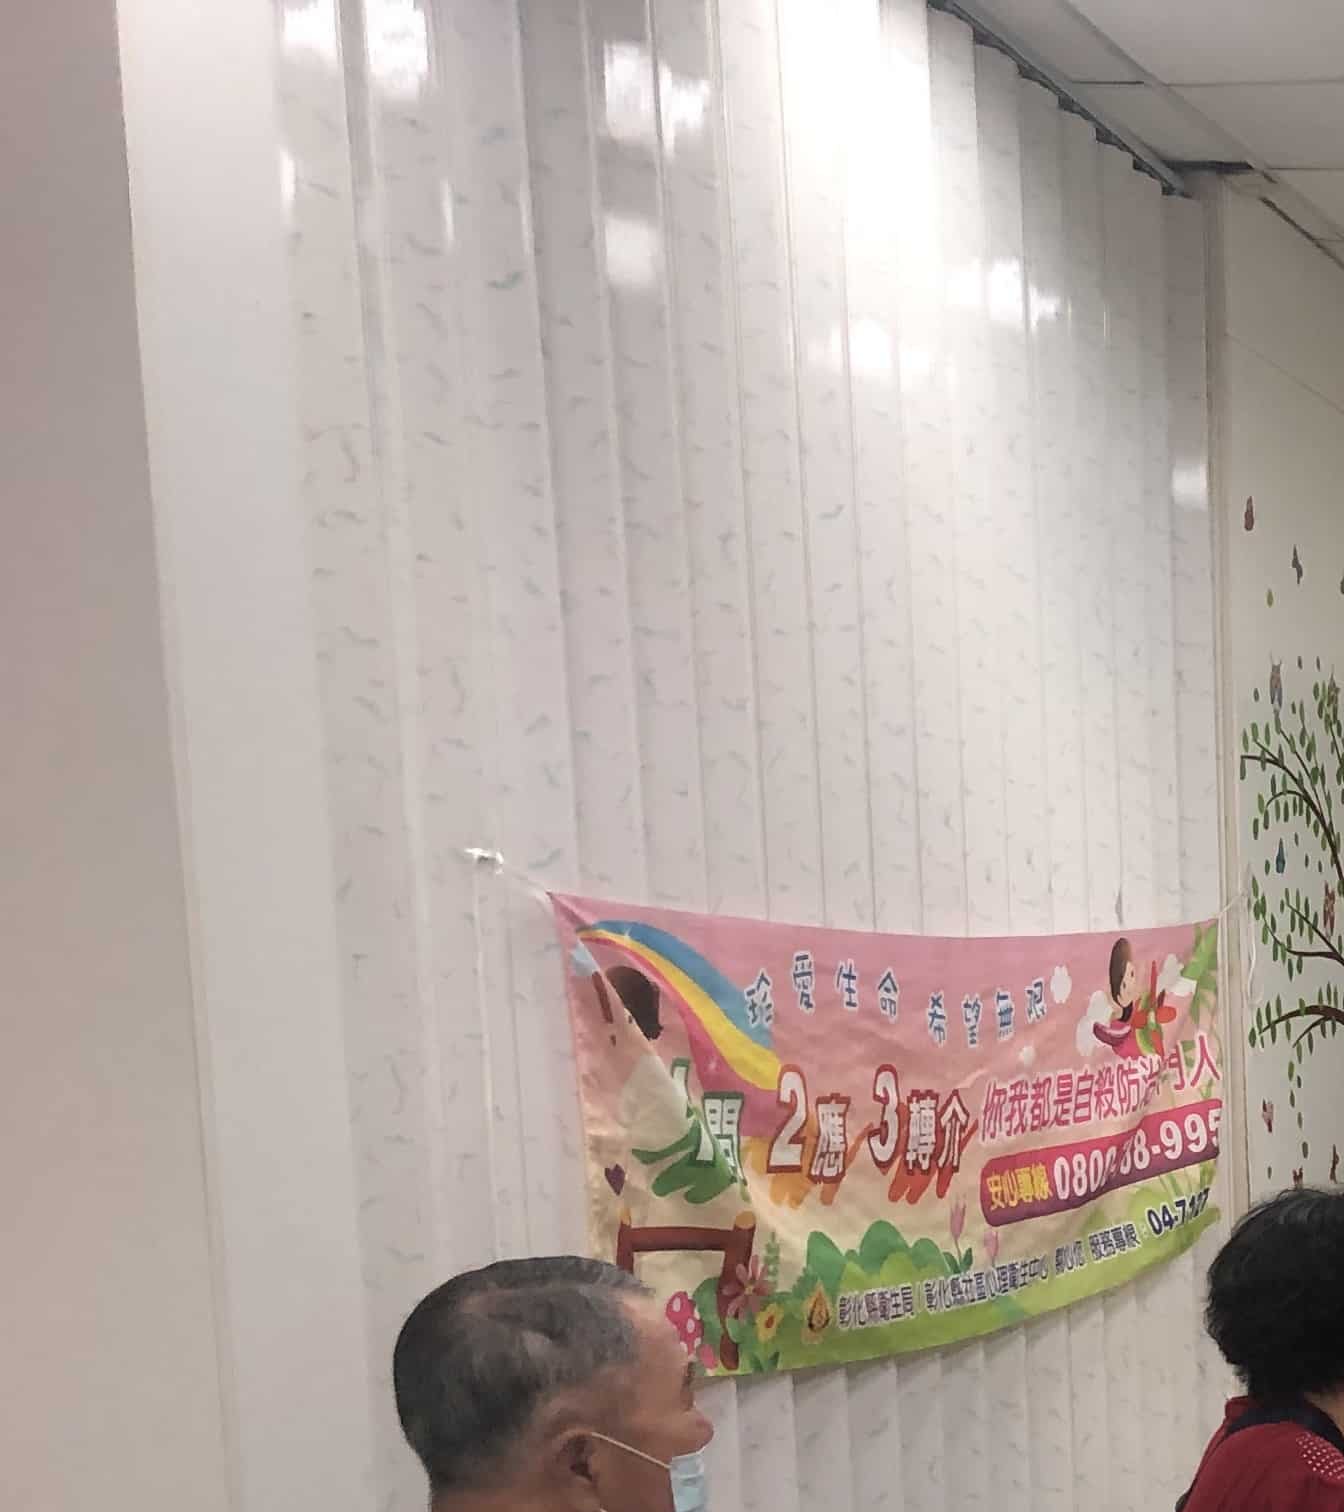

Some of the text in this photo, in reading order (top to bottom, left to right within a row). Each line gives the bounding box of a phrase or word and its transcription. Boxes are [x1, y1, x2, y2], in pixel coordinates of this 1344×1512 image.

[743, 950, 1048, 1048] 珍愛生命 希望無限
[867, 1063, 971, 1176] 3轉介
[986, 1163, 1053, 1211] 安心專線
